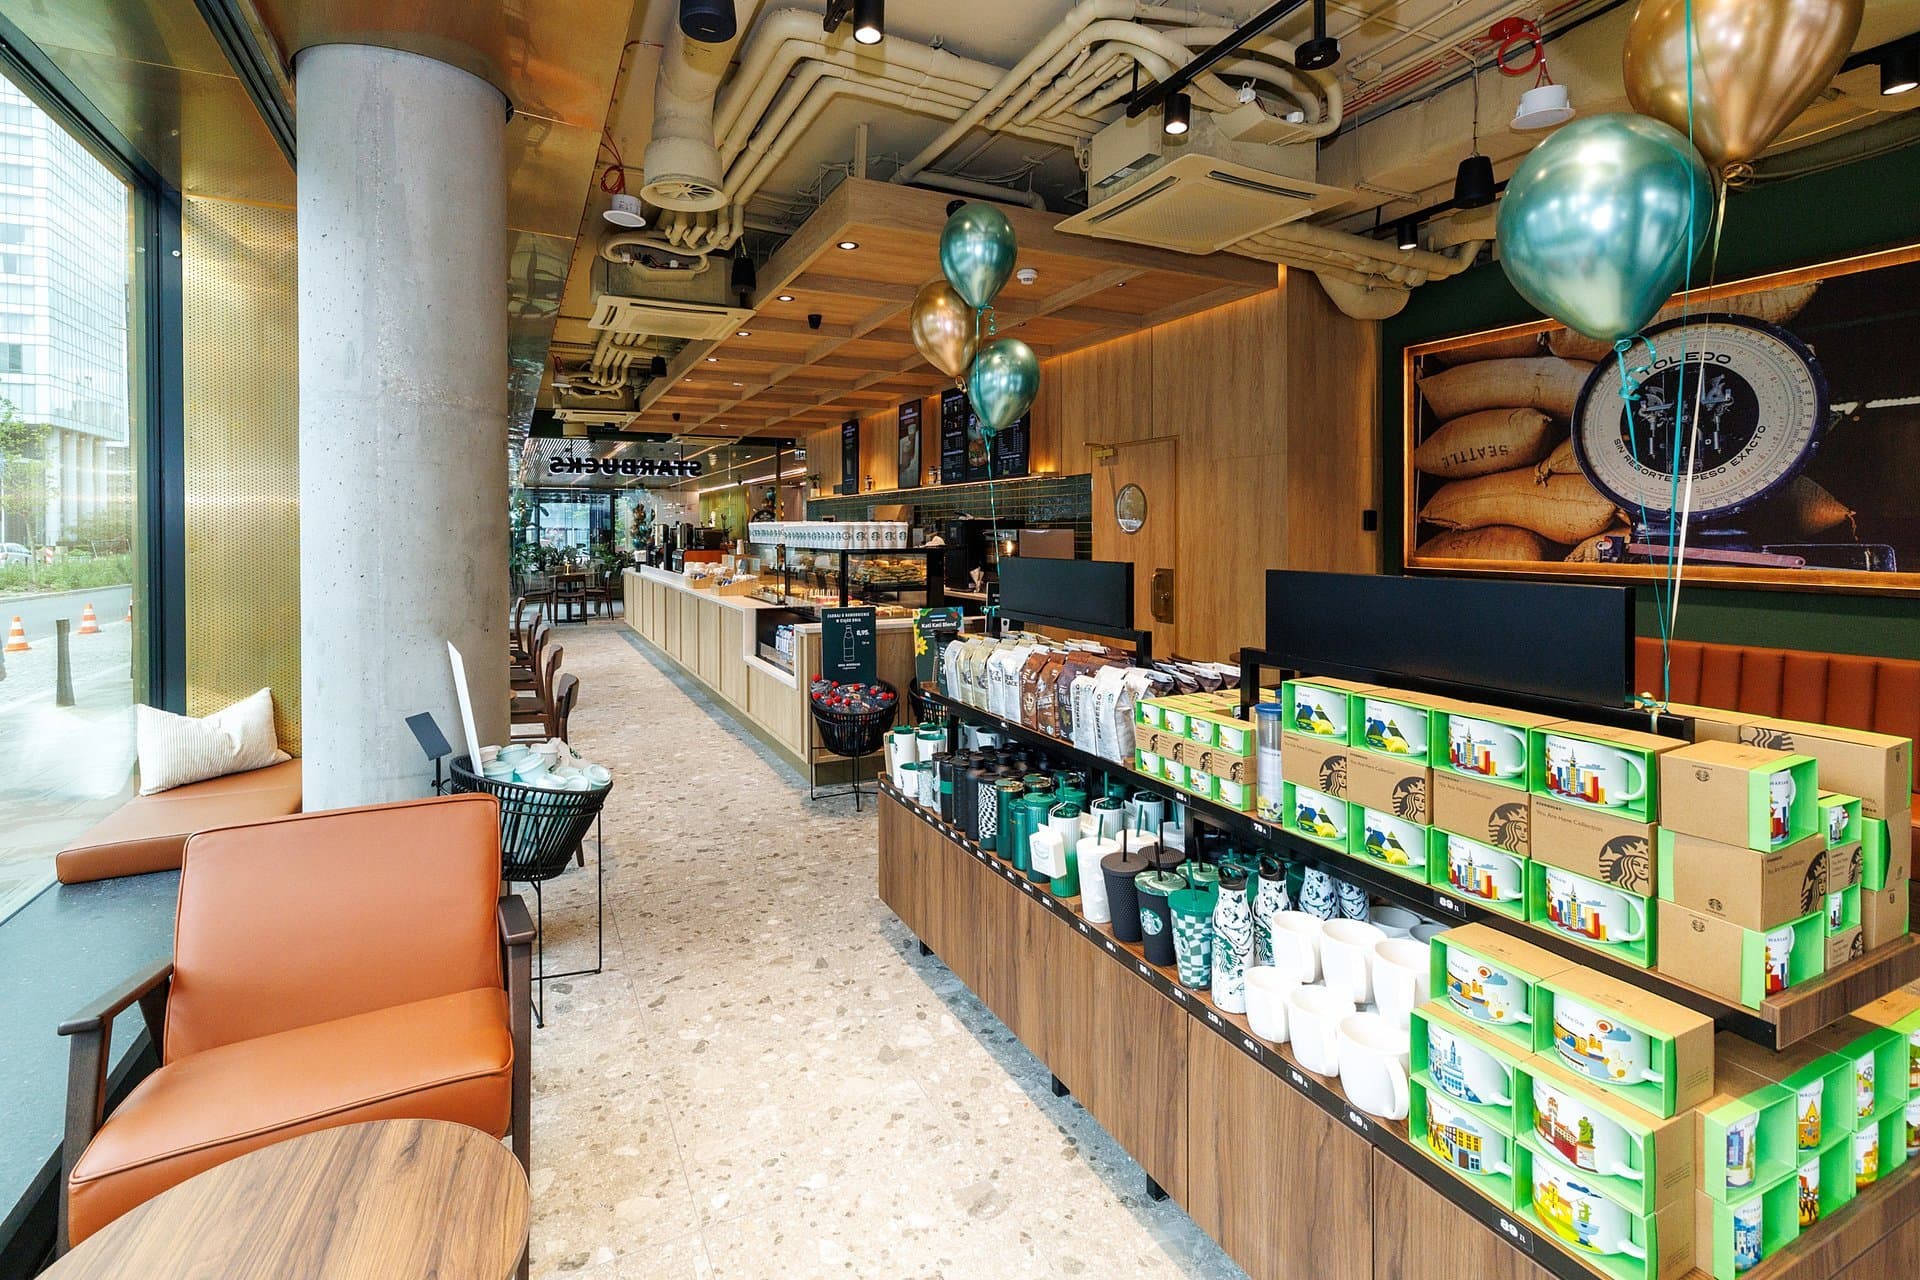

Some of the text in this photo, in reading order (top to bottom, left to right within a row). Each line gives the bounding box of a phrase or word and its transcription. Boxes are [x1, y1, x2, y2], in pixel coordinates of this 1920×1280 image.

[1639, 351, 1731, 376] TOLEDO
[1441, 444, 1509, 468] SEATTLE
[1613, 438, 1625, 454] SIN
[1691, 466, 1726, 483] PESO
[1730, 425, 1766, 467] EXACTO
